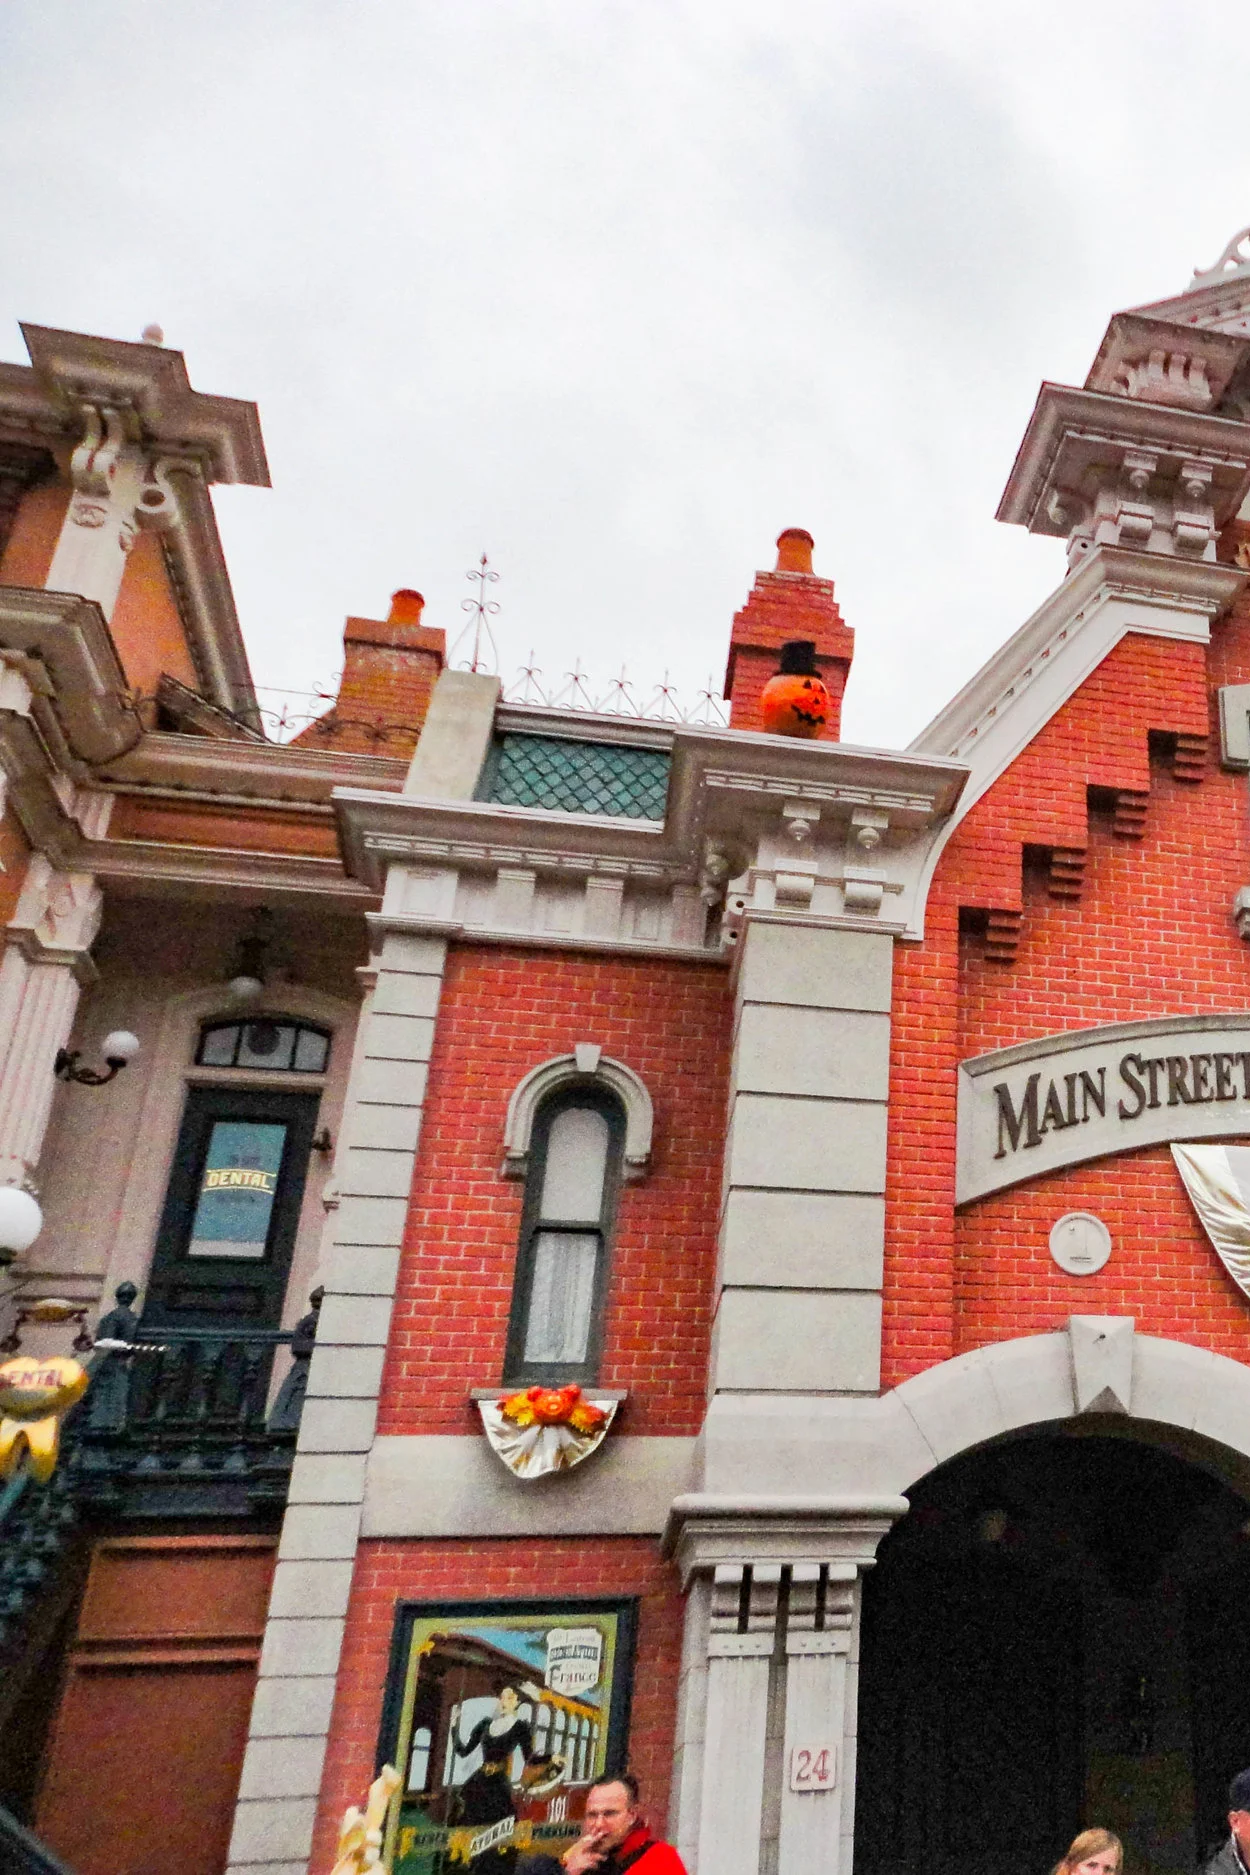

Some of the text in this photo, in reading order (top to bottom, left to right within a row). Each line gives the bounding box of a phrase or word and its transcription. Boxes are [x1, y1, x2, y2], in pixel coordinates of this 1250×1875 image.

[993, 1067, 1107, 1160] MAIN
[206, 1171, 271, 1189] DENTAL
[796, 1749, 831, 1782] 24
